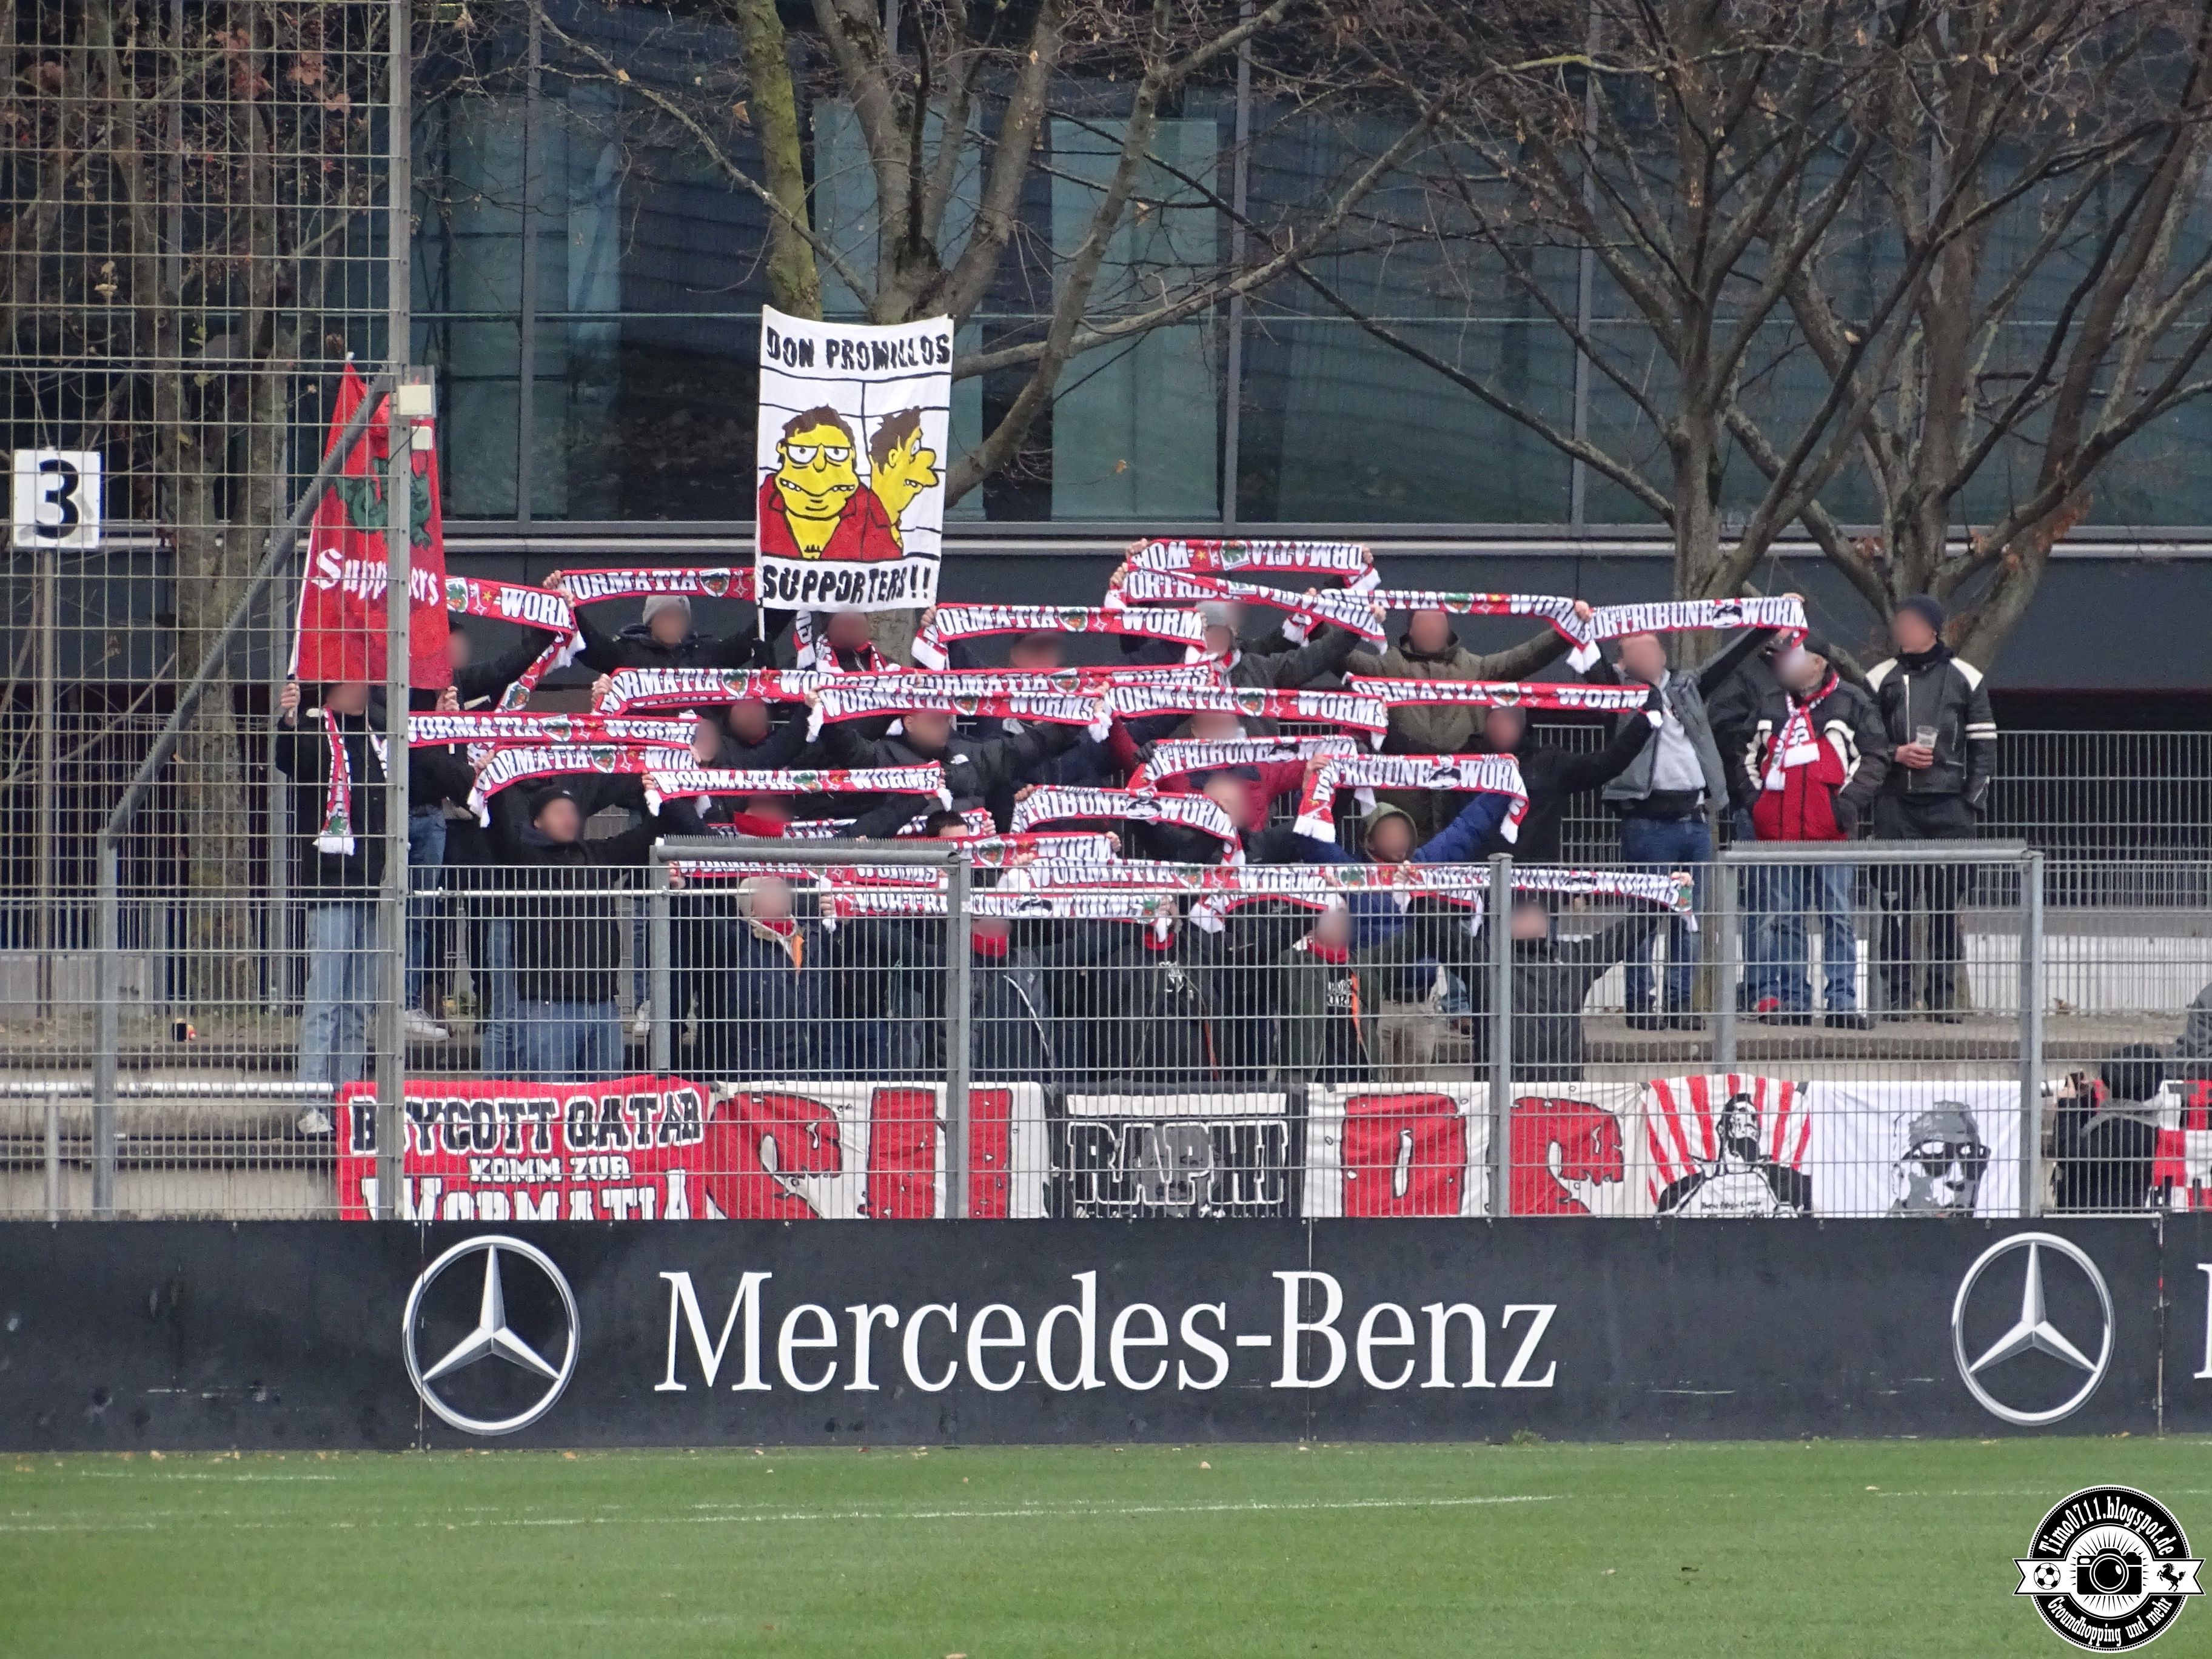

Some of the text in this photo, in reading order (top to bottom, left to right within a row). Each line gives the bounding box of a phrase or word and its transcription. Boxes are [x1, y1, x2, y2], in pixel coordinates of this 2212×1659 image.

[766, 326, 951, 371] DON PROMILLOS
[34, 458, 79, 540] 3
[1250, 540, 1362, 570] ORMATIA
[762, 564, 932, 604] SUPPORTERS!!
[500, 586, 571, 628] WORM
[936, 606, 1204, 641] ORMATIA WORM
[1741, 597, 1808, 628] WORM
[819, 687, 1095, 722] WORMATIA WORMS
[1298, 691, 1389, 728] WORMS
[1352, 680, 1649, 709] ORMATIA WORM
[655, 767, 940, 793] WORMATIA WORMS
[1460, 760, 1528, 797] WORM
[1157, 797, 1236, 839] WORM
[1035, 835, 1111, 859] WORM
[1030, 856, 1175, 888] WORMATIA
[348, 1087, 703, 1156] BYCOTT QATAR
[469, 1155, 632, 1183] KOMM ZUR
[654, 1270, 1559, 1392] Mercedes-Benz
